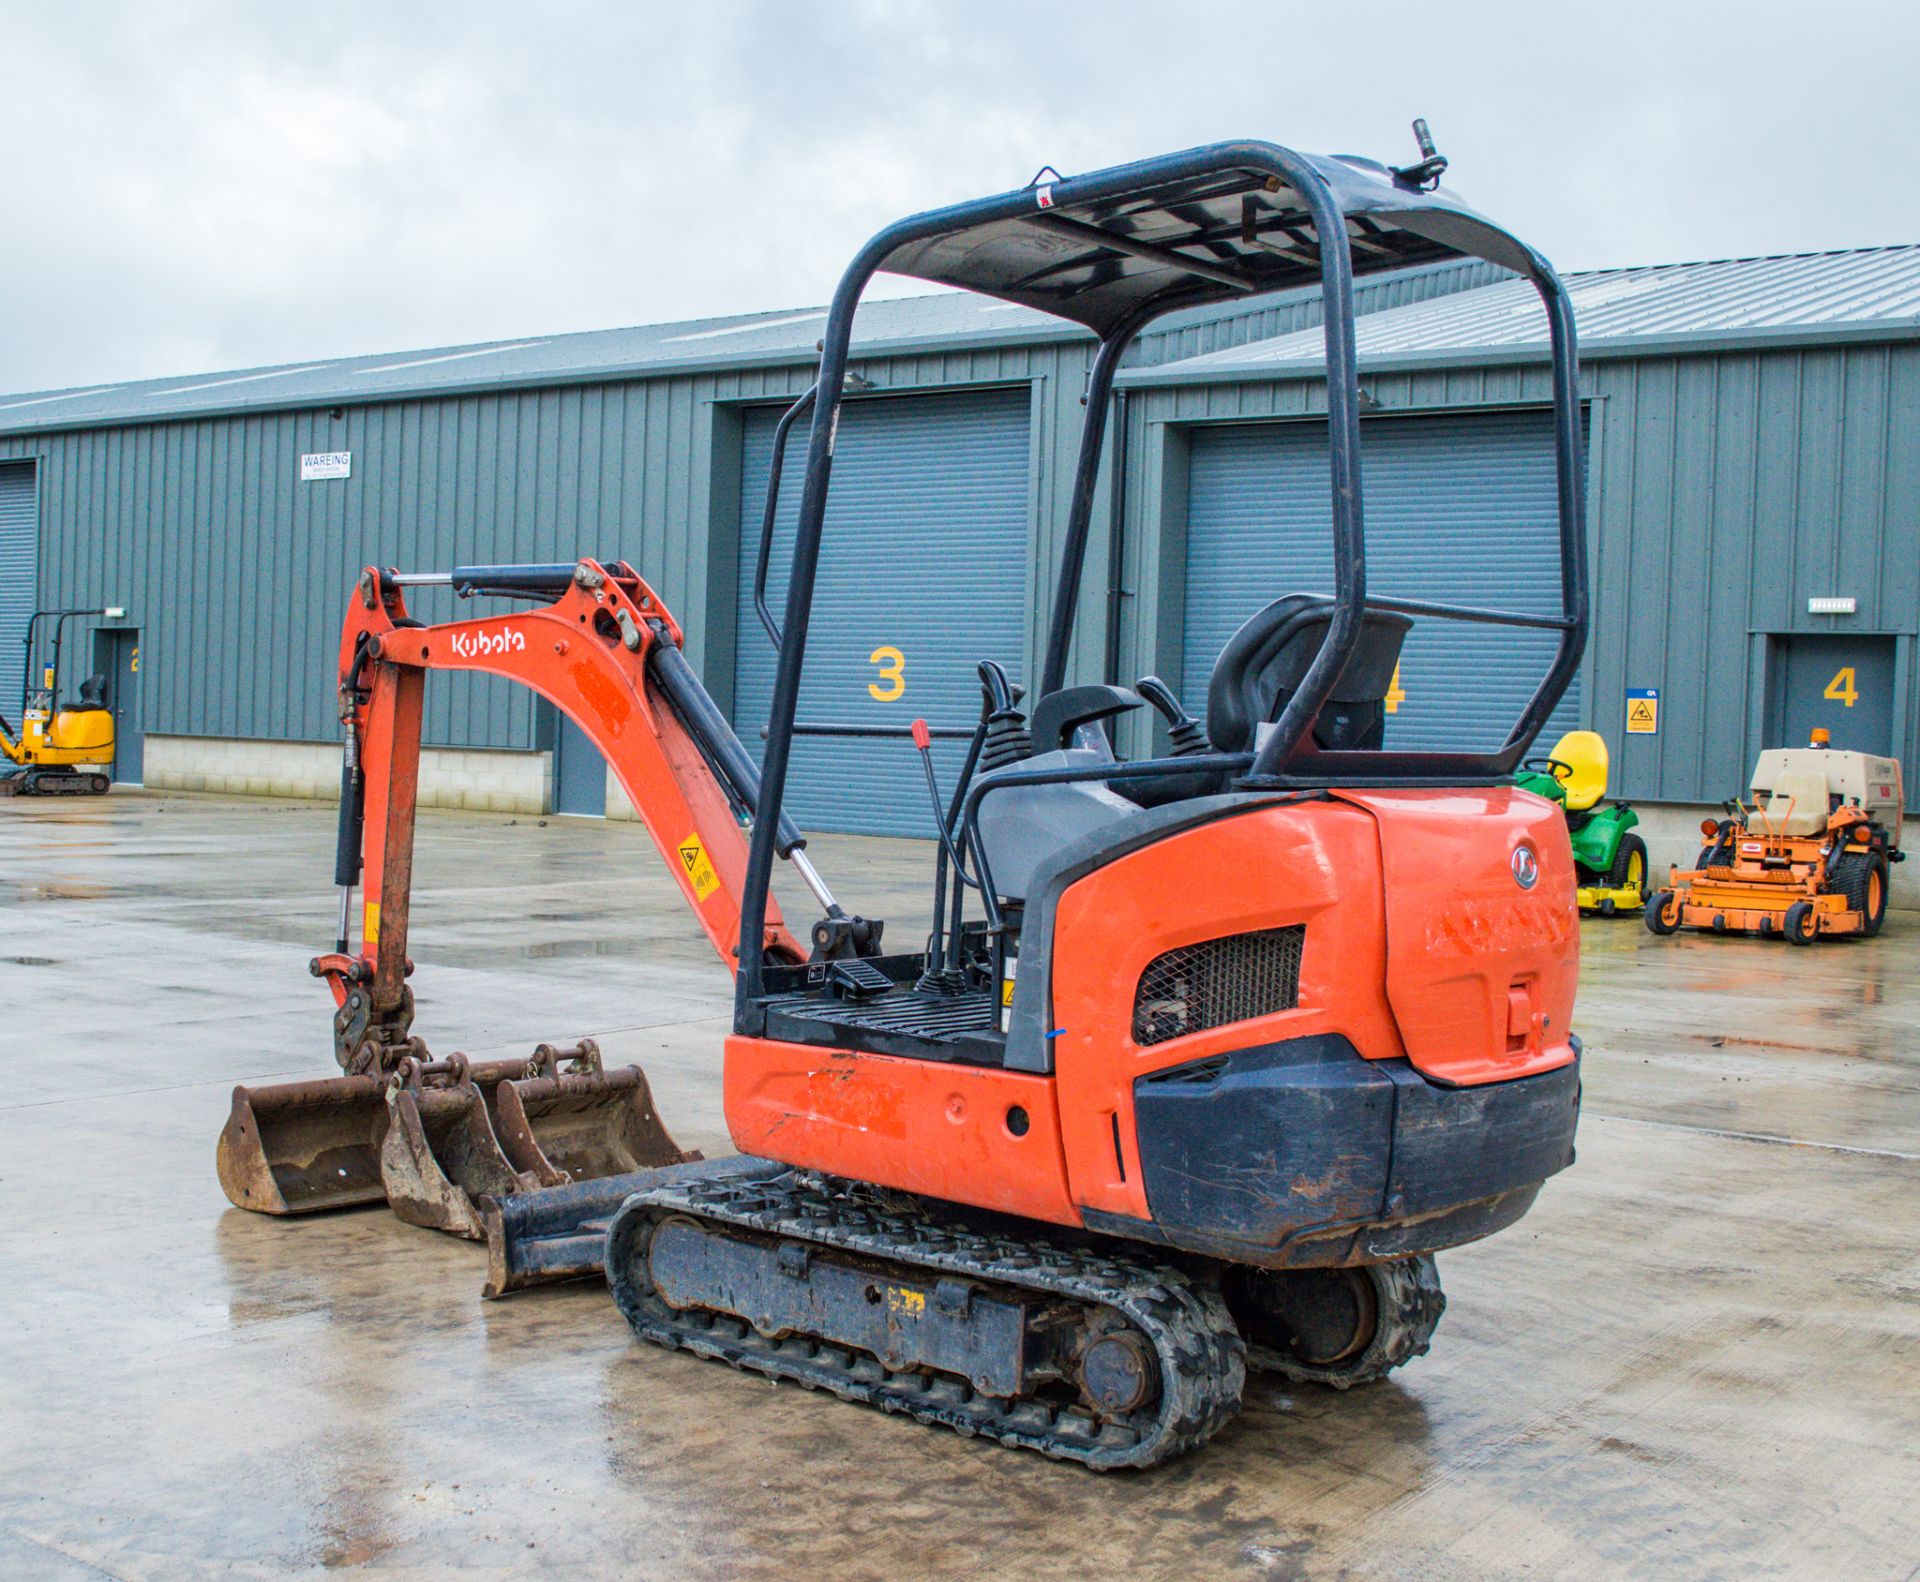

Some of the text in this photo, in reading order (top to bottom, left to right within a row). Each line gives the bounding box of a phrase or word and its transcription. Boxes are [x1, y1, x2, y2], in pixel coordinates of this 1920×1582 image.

[304, 454, 349, 466] WAREING
[452, 626, 525, 658] Kubota
[868, 646, 905, 702] 3
[1824, 667, 1859, 707] 4
